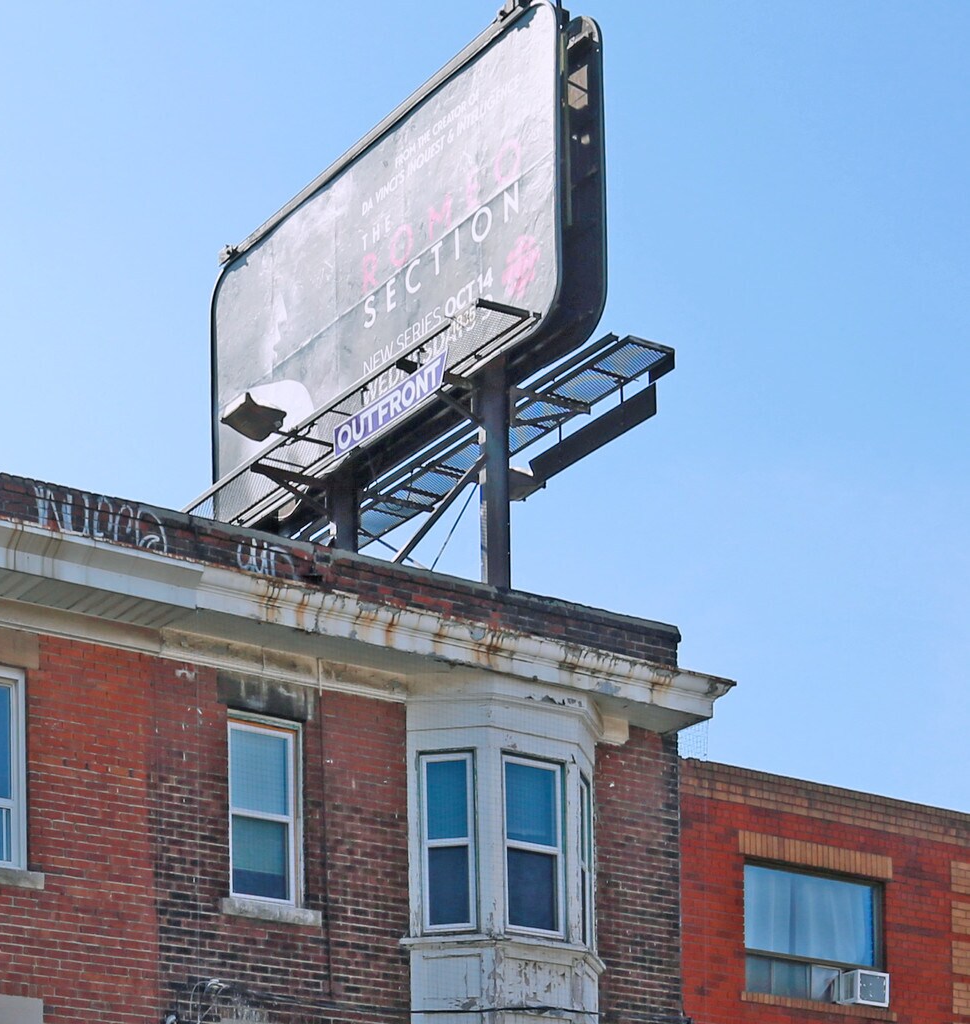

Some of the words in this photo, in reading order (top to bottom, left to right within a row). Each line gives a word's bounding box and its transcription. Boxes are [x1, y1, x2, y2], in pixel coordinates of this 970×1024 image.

[362, 197, 373, 216] DA
[407, 135, 445, 177] INQUEST
[394, 145, 416, 169] FROM
[417, 131, 430, 149] THE
[432, 102, 466, 136] CREATOR
[361, 214, 391, 251] THE
[363, 181, 520, 329] SECTION
[363, 342, 394, 376] NEW
[397, 307, 442, 348] SERIES
[444, 281, 475, 316] OCT
[479, 267, 494, 293] 14
[337, 357, 443, 451] OUTFRONT
